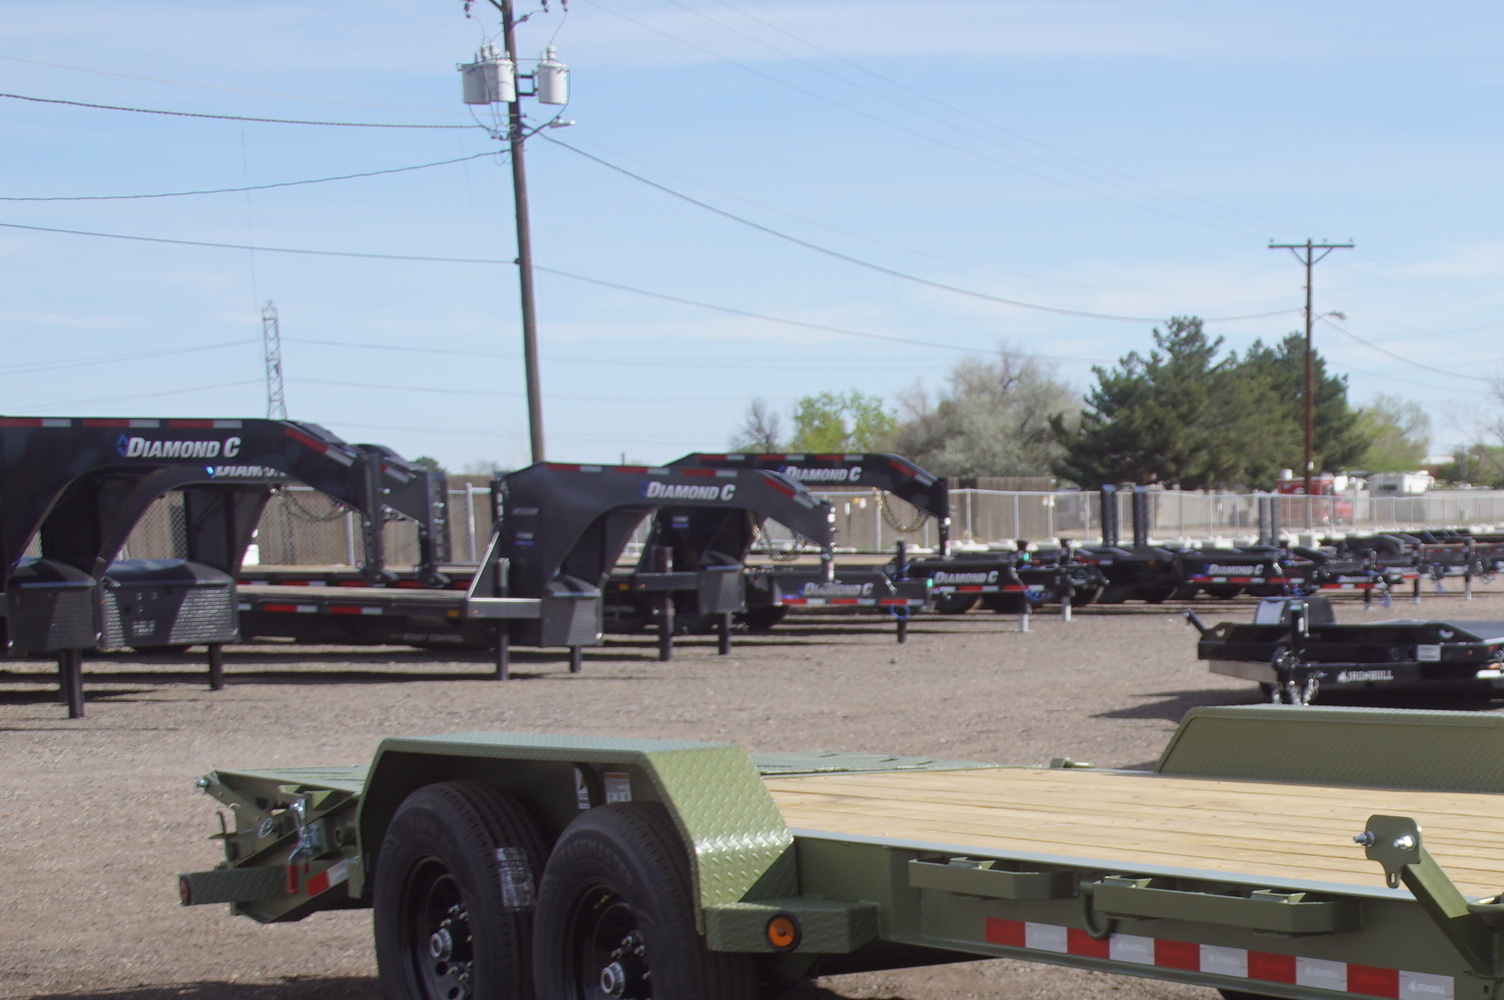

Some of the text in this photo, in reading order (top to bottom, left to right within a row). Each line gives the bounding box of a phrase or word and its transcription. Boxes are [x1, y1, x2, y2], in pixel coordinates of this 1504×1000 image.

[126, 436, 242, 459] DIAMOND C
[786, 465, 863, 482] DIAMOND C
[646, 481, 736, 501] DIAMOND C
[934, 570, 999, 584] DIAMOND C
[862, 582, 874, 596] C
[1349, 669, 1394, 681] IRONBULL
